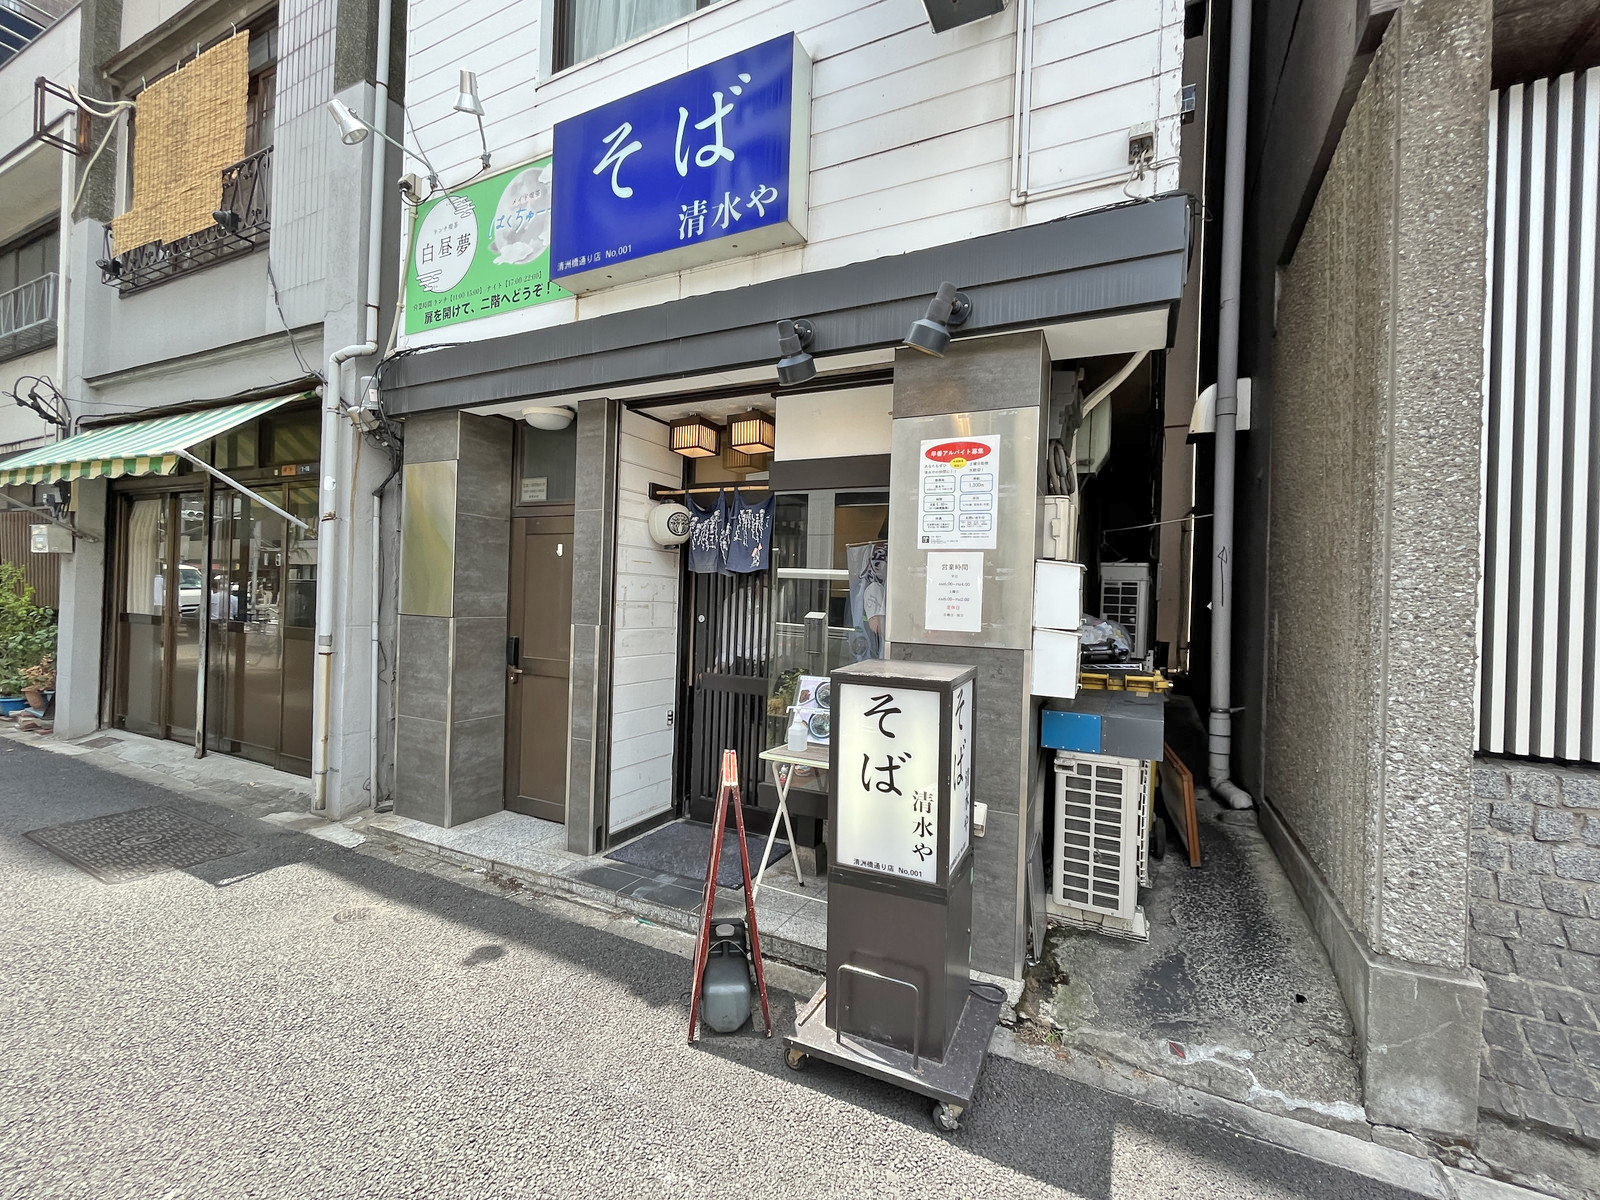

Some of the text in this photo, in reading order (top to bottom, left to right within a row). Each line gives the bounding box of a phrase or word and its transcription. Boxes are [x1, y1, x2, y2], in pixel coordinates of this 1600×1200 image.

[592, 72, 752, 199] そば
[488, 206, 551, 241] はくちゅー
[678, 184, 779, 241] 清水や
[422, 231, 472, 265] 白昼夢
[557, 251, 602, 272] 清洲橋通り店
[861, 693, 912, 797] そば
[953, 687, 967, 791] そば
[912, 790, 934, 863] 清水や
[853, 857, 895, 873] 清洲橋通り店
